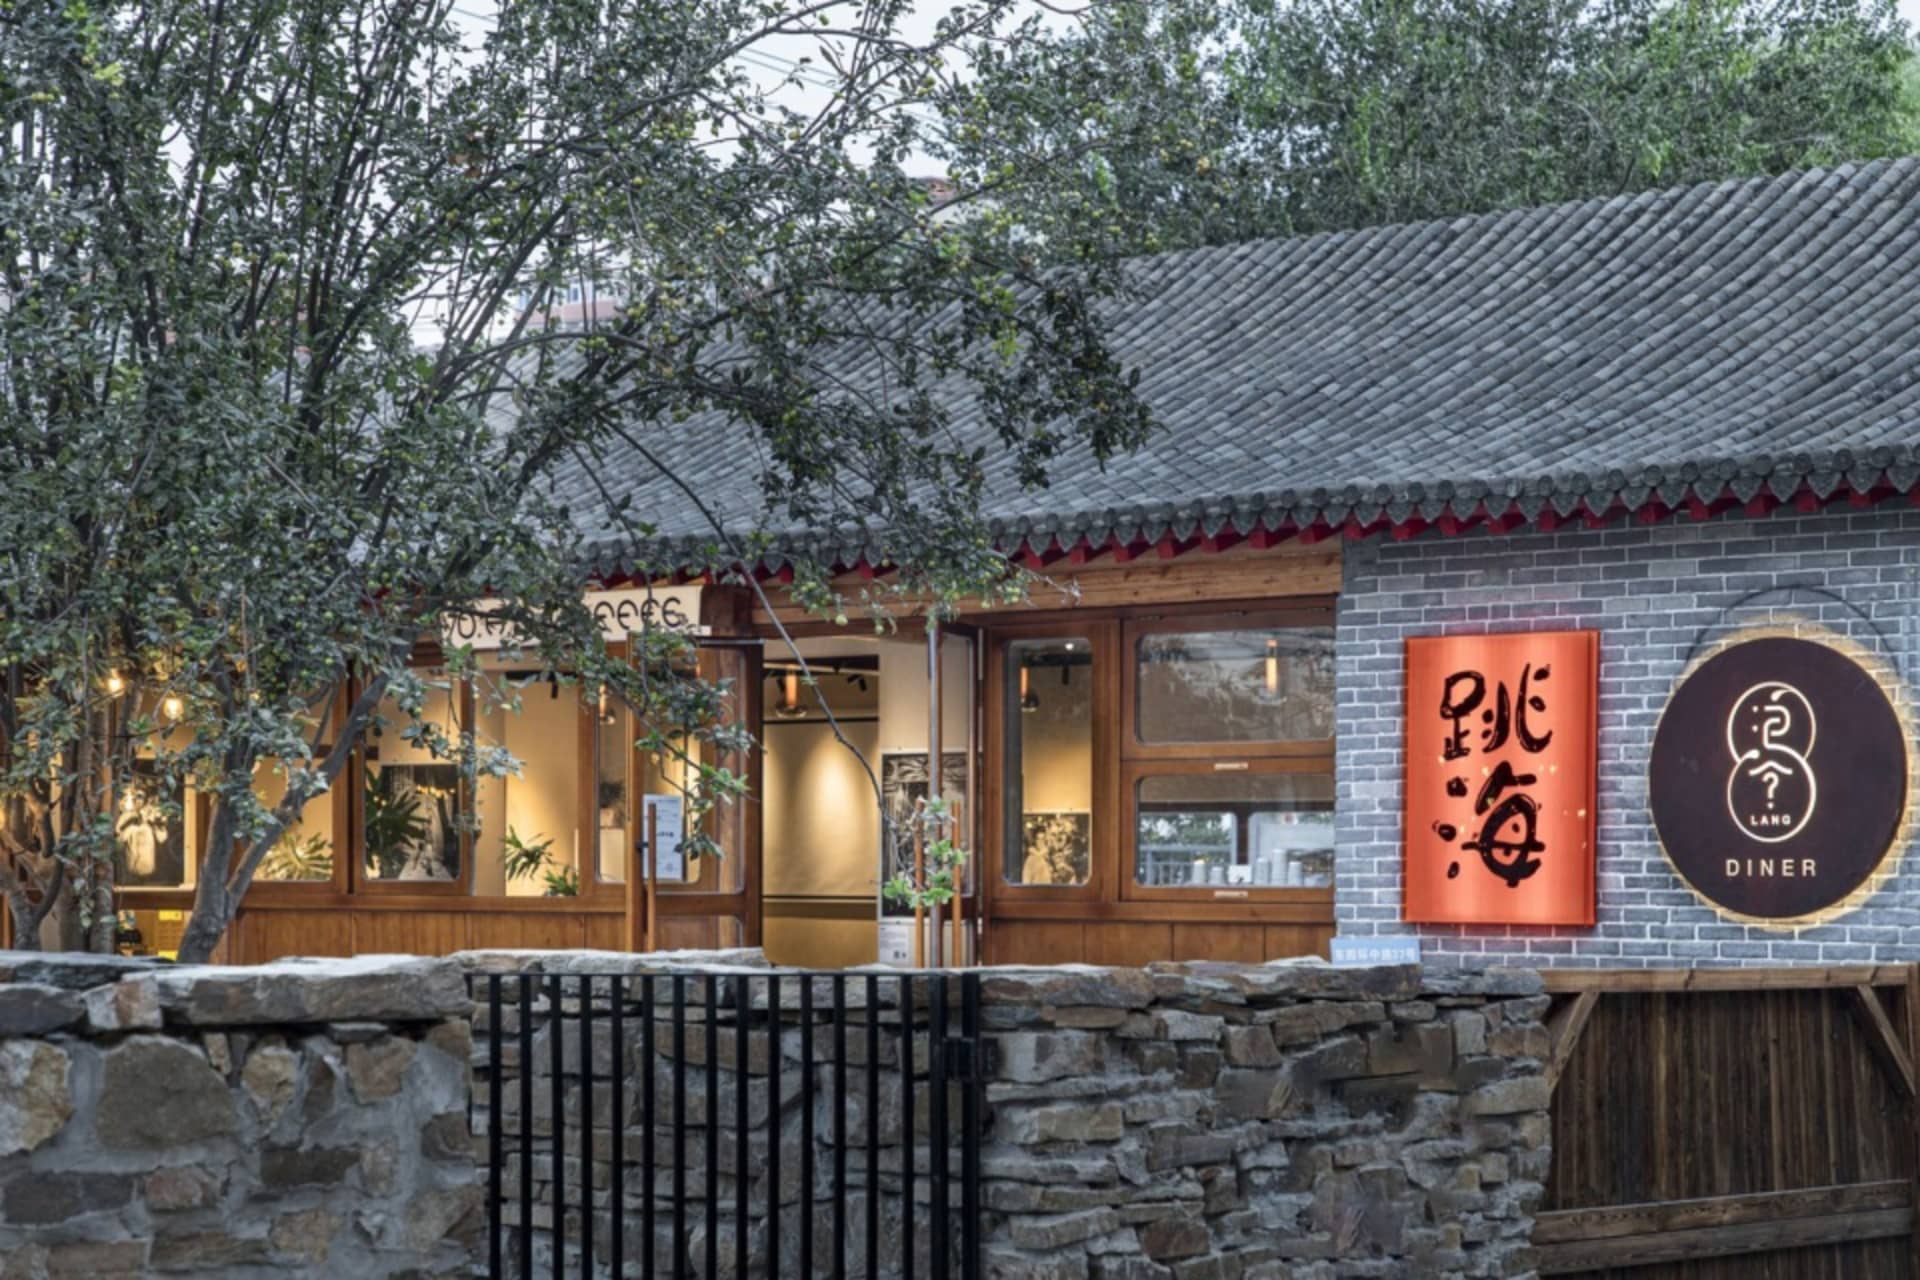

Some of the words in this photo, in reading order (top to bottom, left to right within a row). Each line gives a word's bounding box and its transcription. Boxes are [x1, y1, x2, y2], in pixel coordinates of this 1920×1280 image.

[1432, 662, 1553, 888] 跳海
[1750, 815, 1792, 826] LANG
[1725, 858, 1817, 877] DINER
